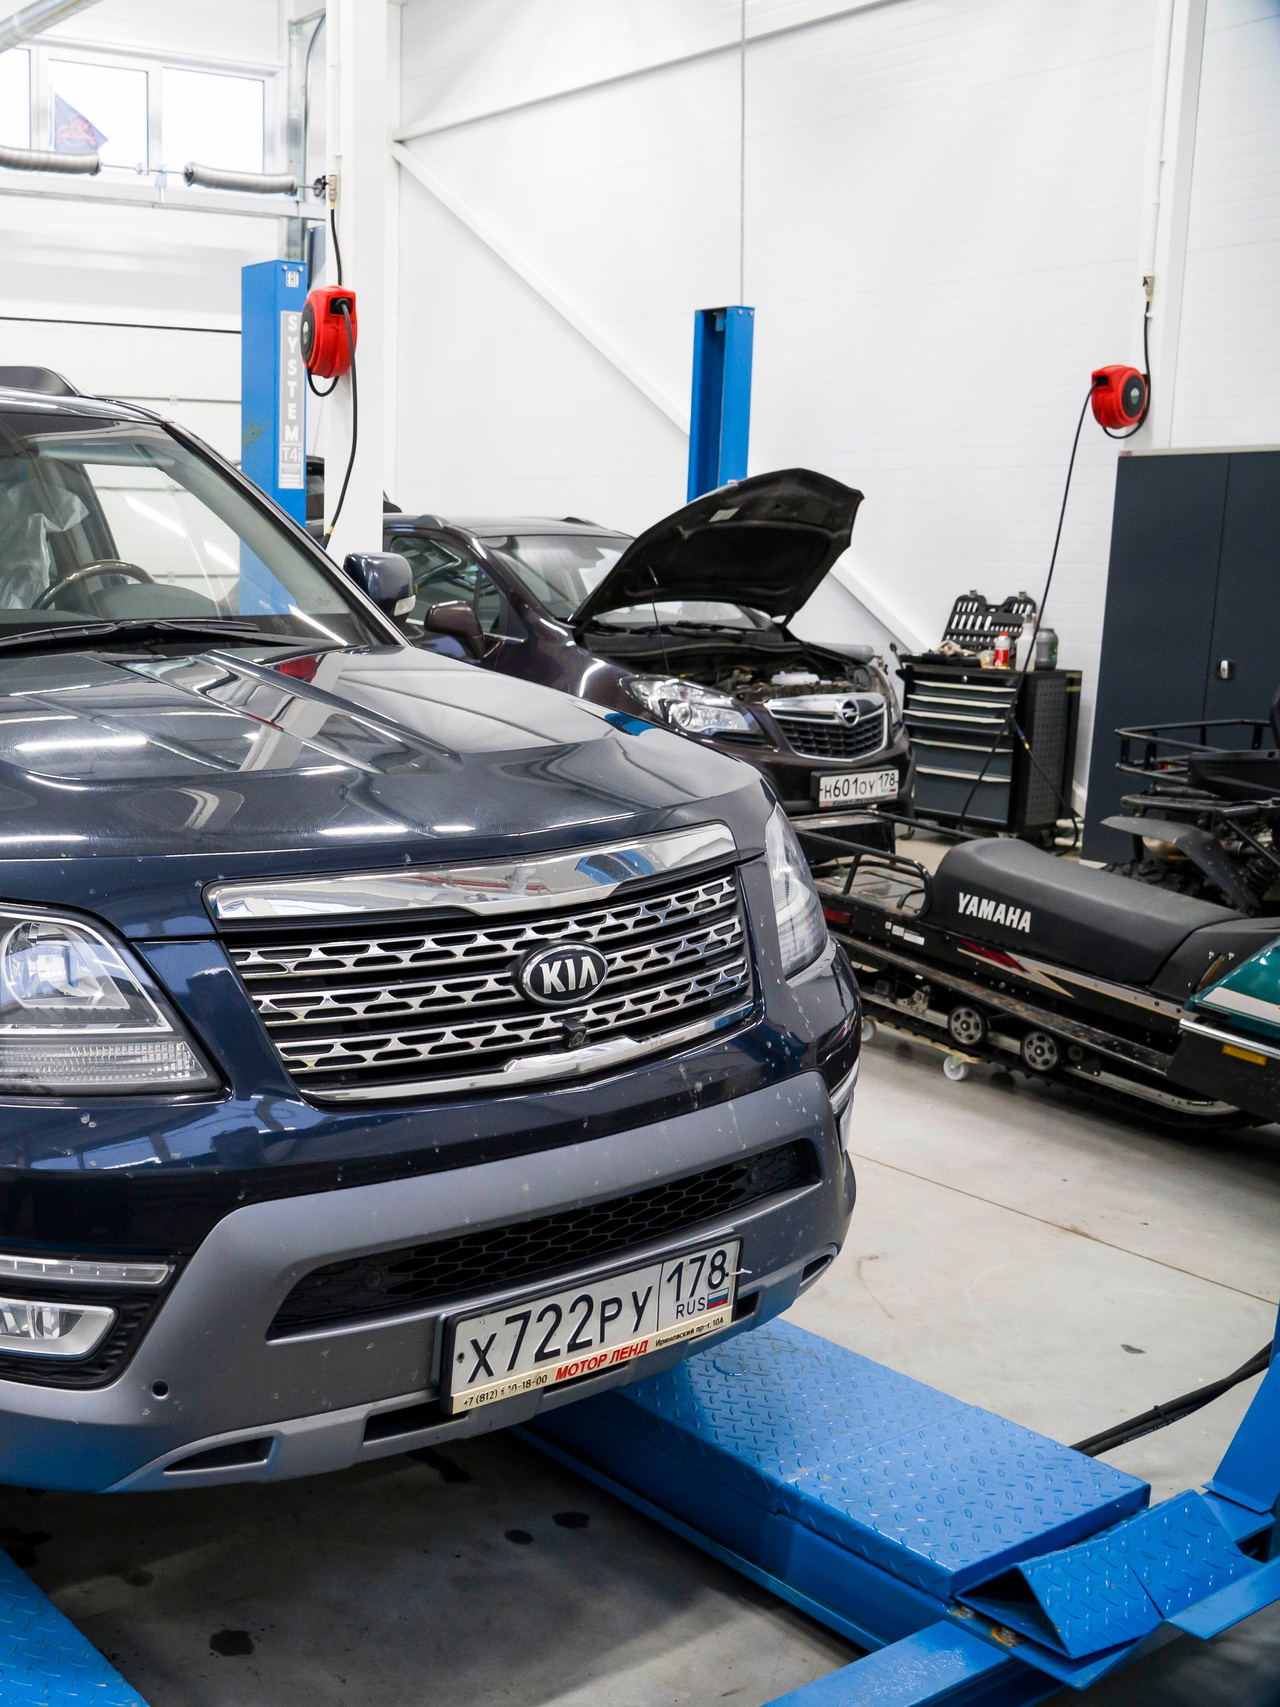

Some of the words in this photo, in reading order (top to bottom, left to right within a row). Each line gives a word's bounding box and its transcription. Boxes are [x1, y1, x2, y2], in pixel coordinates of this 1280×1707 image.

[285, 314, 299, 442] SYSTEM
[281, 447, 302, 463] T4i
[878, 772, 896, 788] 178
[958, 892, 1031, 934] YAMAHA
[540, 956, 598, 994] KIA
[666, 1249, 727, 1302] 178
[675, 1296, 706, 1319] RUS
[463, 1396, 474, 1407] +7
[476, 1388, 498, 1405] (812)
[555, 1353, 608, 1381] МОТОР
[609, 1340, 649, 1364] ЛЕНД
